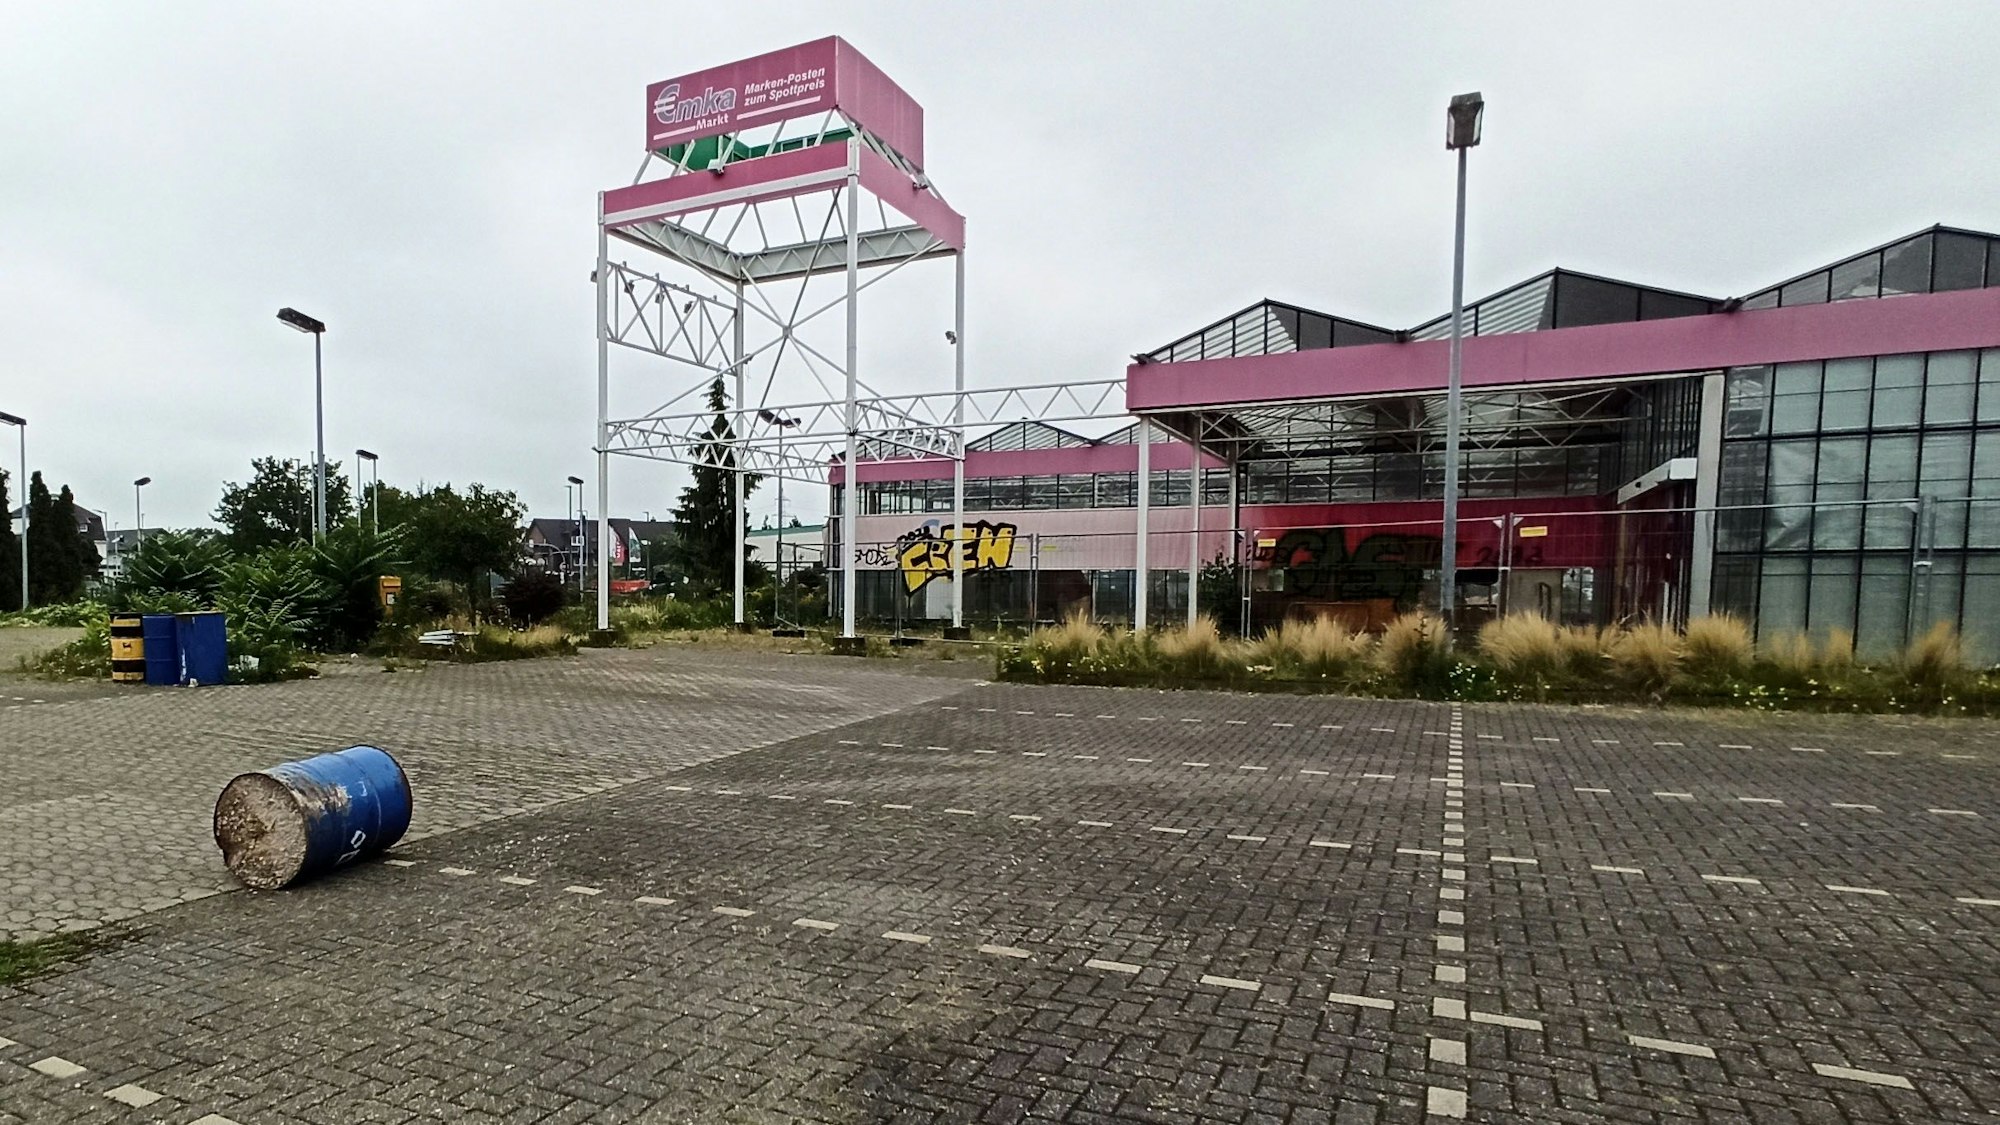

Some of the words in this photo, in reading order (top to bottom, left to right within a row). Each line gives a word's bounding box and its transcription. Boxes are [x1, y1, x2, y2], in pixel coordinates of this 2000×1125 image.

[744, 67, 825, 95] Marken-Posten
[744, 94, 766, 107] zum
[769, 78, 825, 101] Spottpreis
[696, 113, 729, 130] Markt
